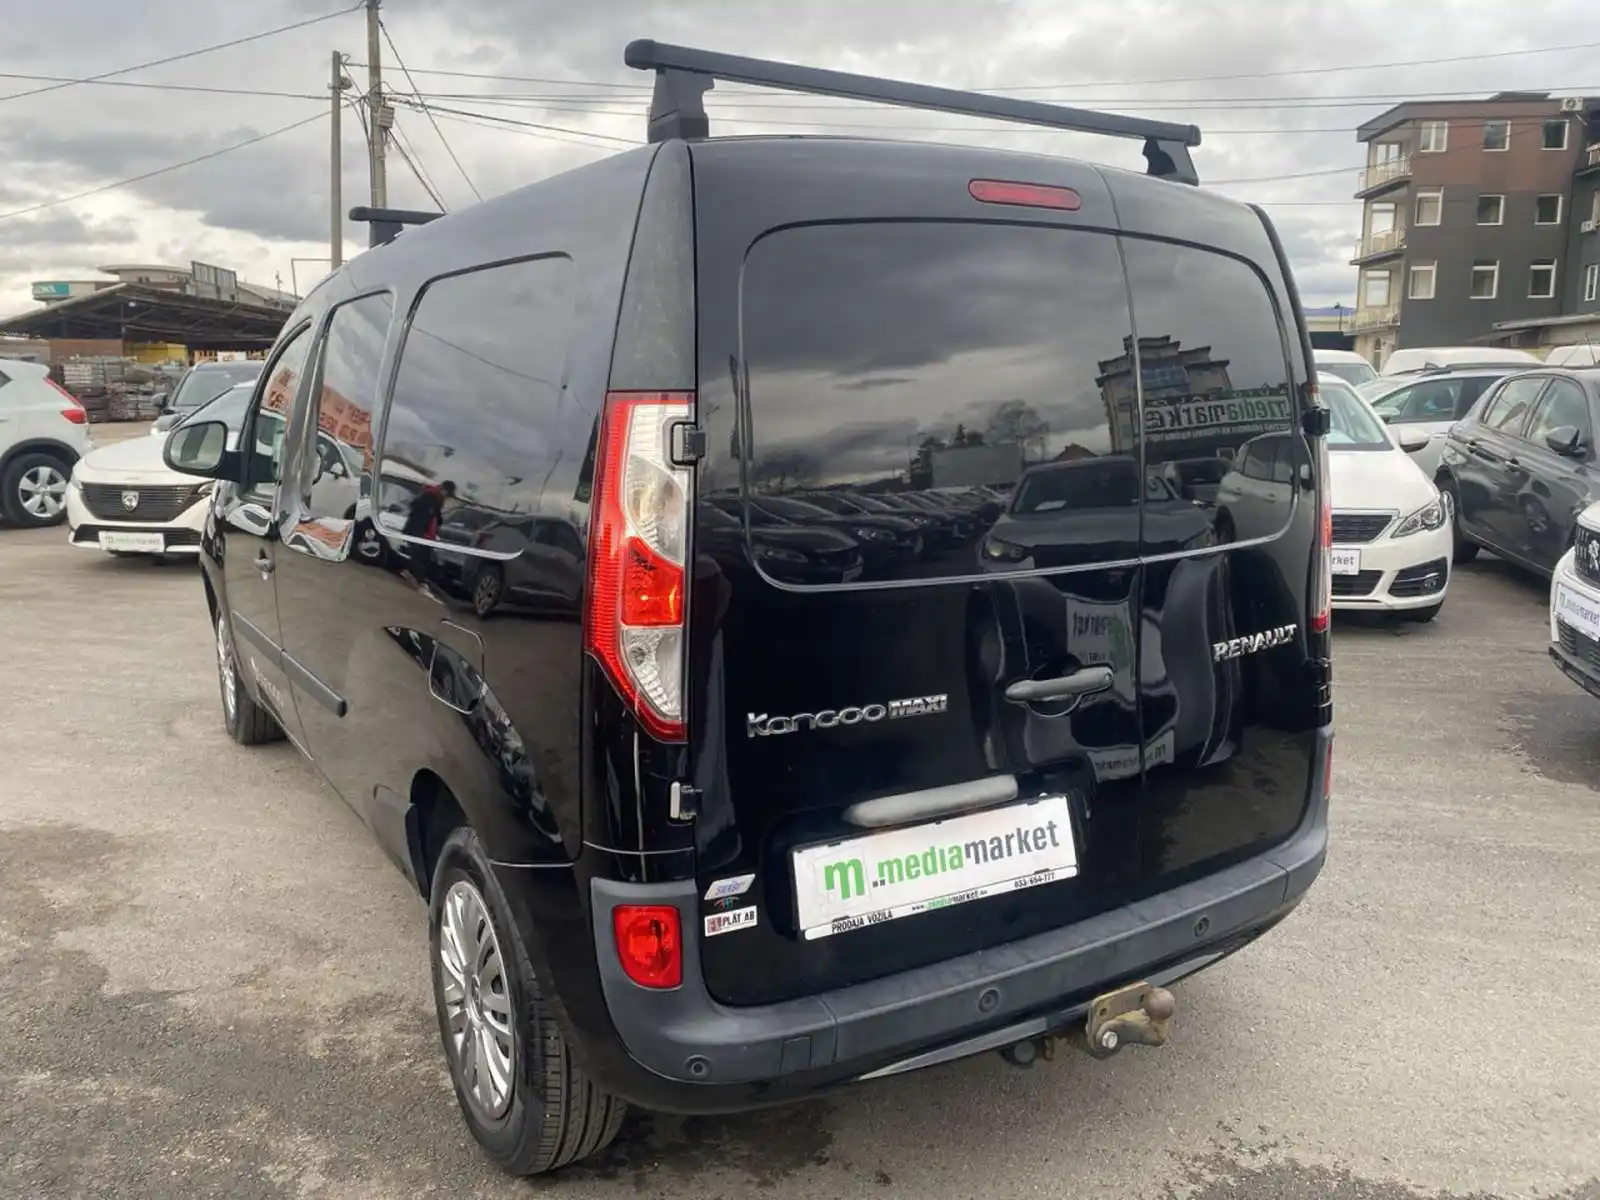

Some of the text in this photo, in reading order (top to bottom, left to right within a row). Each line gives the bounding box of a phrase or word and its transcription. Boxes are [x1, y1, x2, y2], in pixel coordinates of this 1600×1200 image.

[1212, 624, 1297, 662] RENAULT
[888, 694, 948, 719] MAXI
[831, 915, 865, 933] PRODAJA
